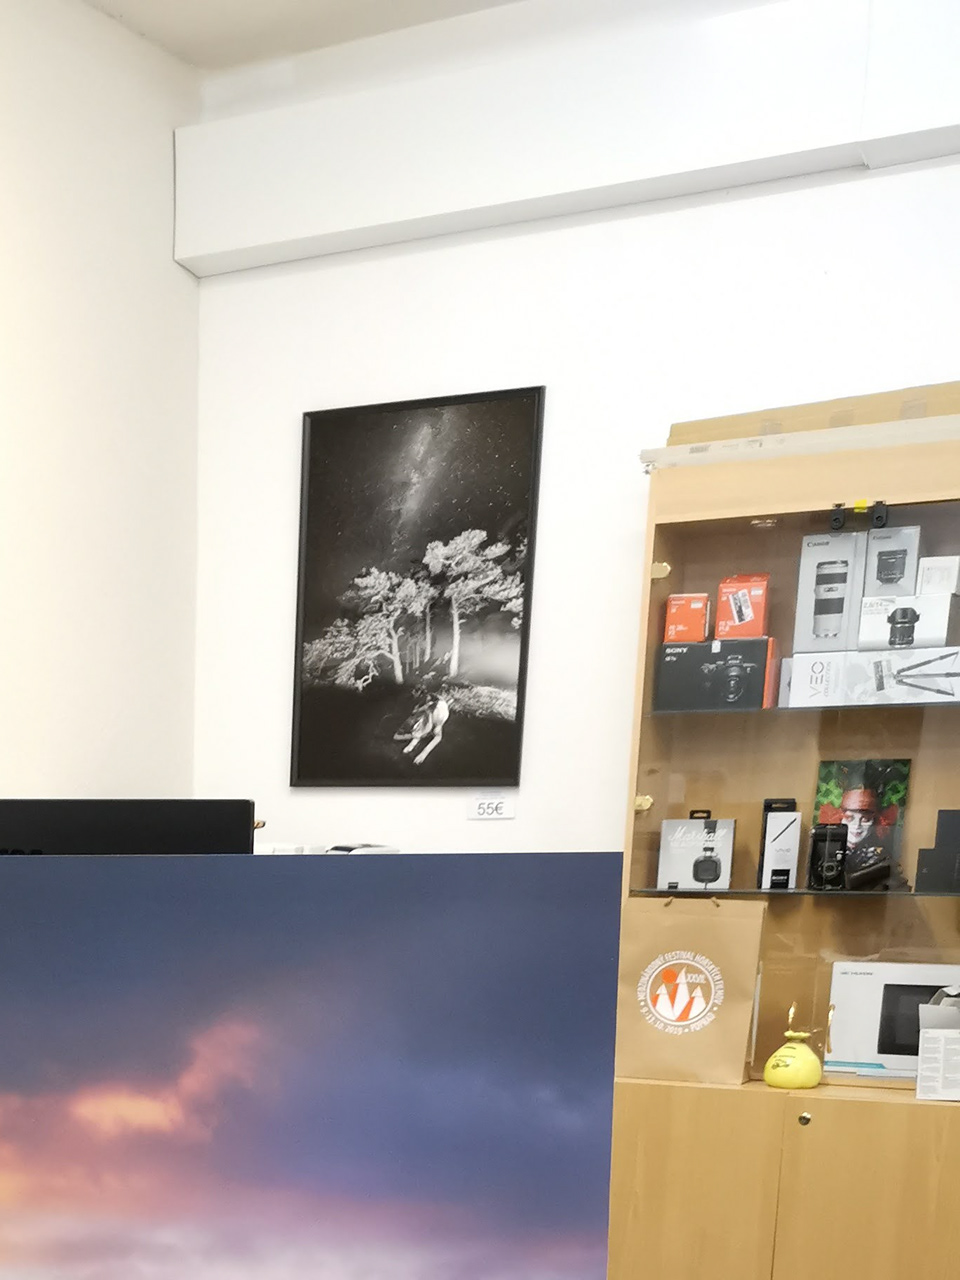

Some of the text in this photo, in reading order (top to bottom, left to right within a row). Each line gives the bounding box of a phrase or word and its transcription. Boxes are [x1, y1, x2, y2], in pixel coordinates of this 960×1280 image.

[809, 661, 825, 698] VEO
[477, 801, 504, 816] 55€
[668, 826, 728, 841] Marshall
